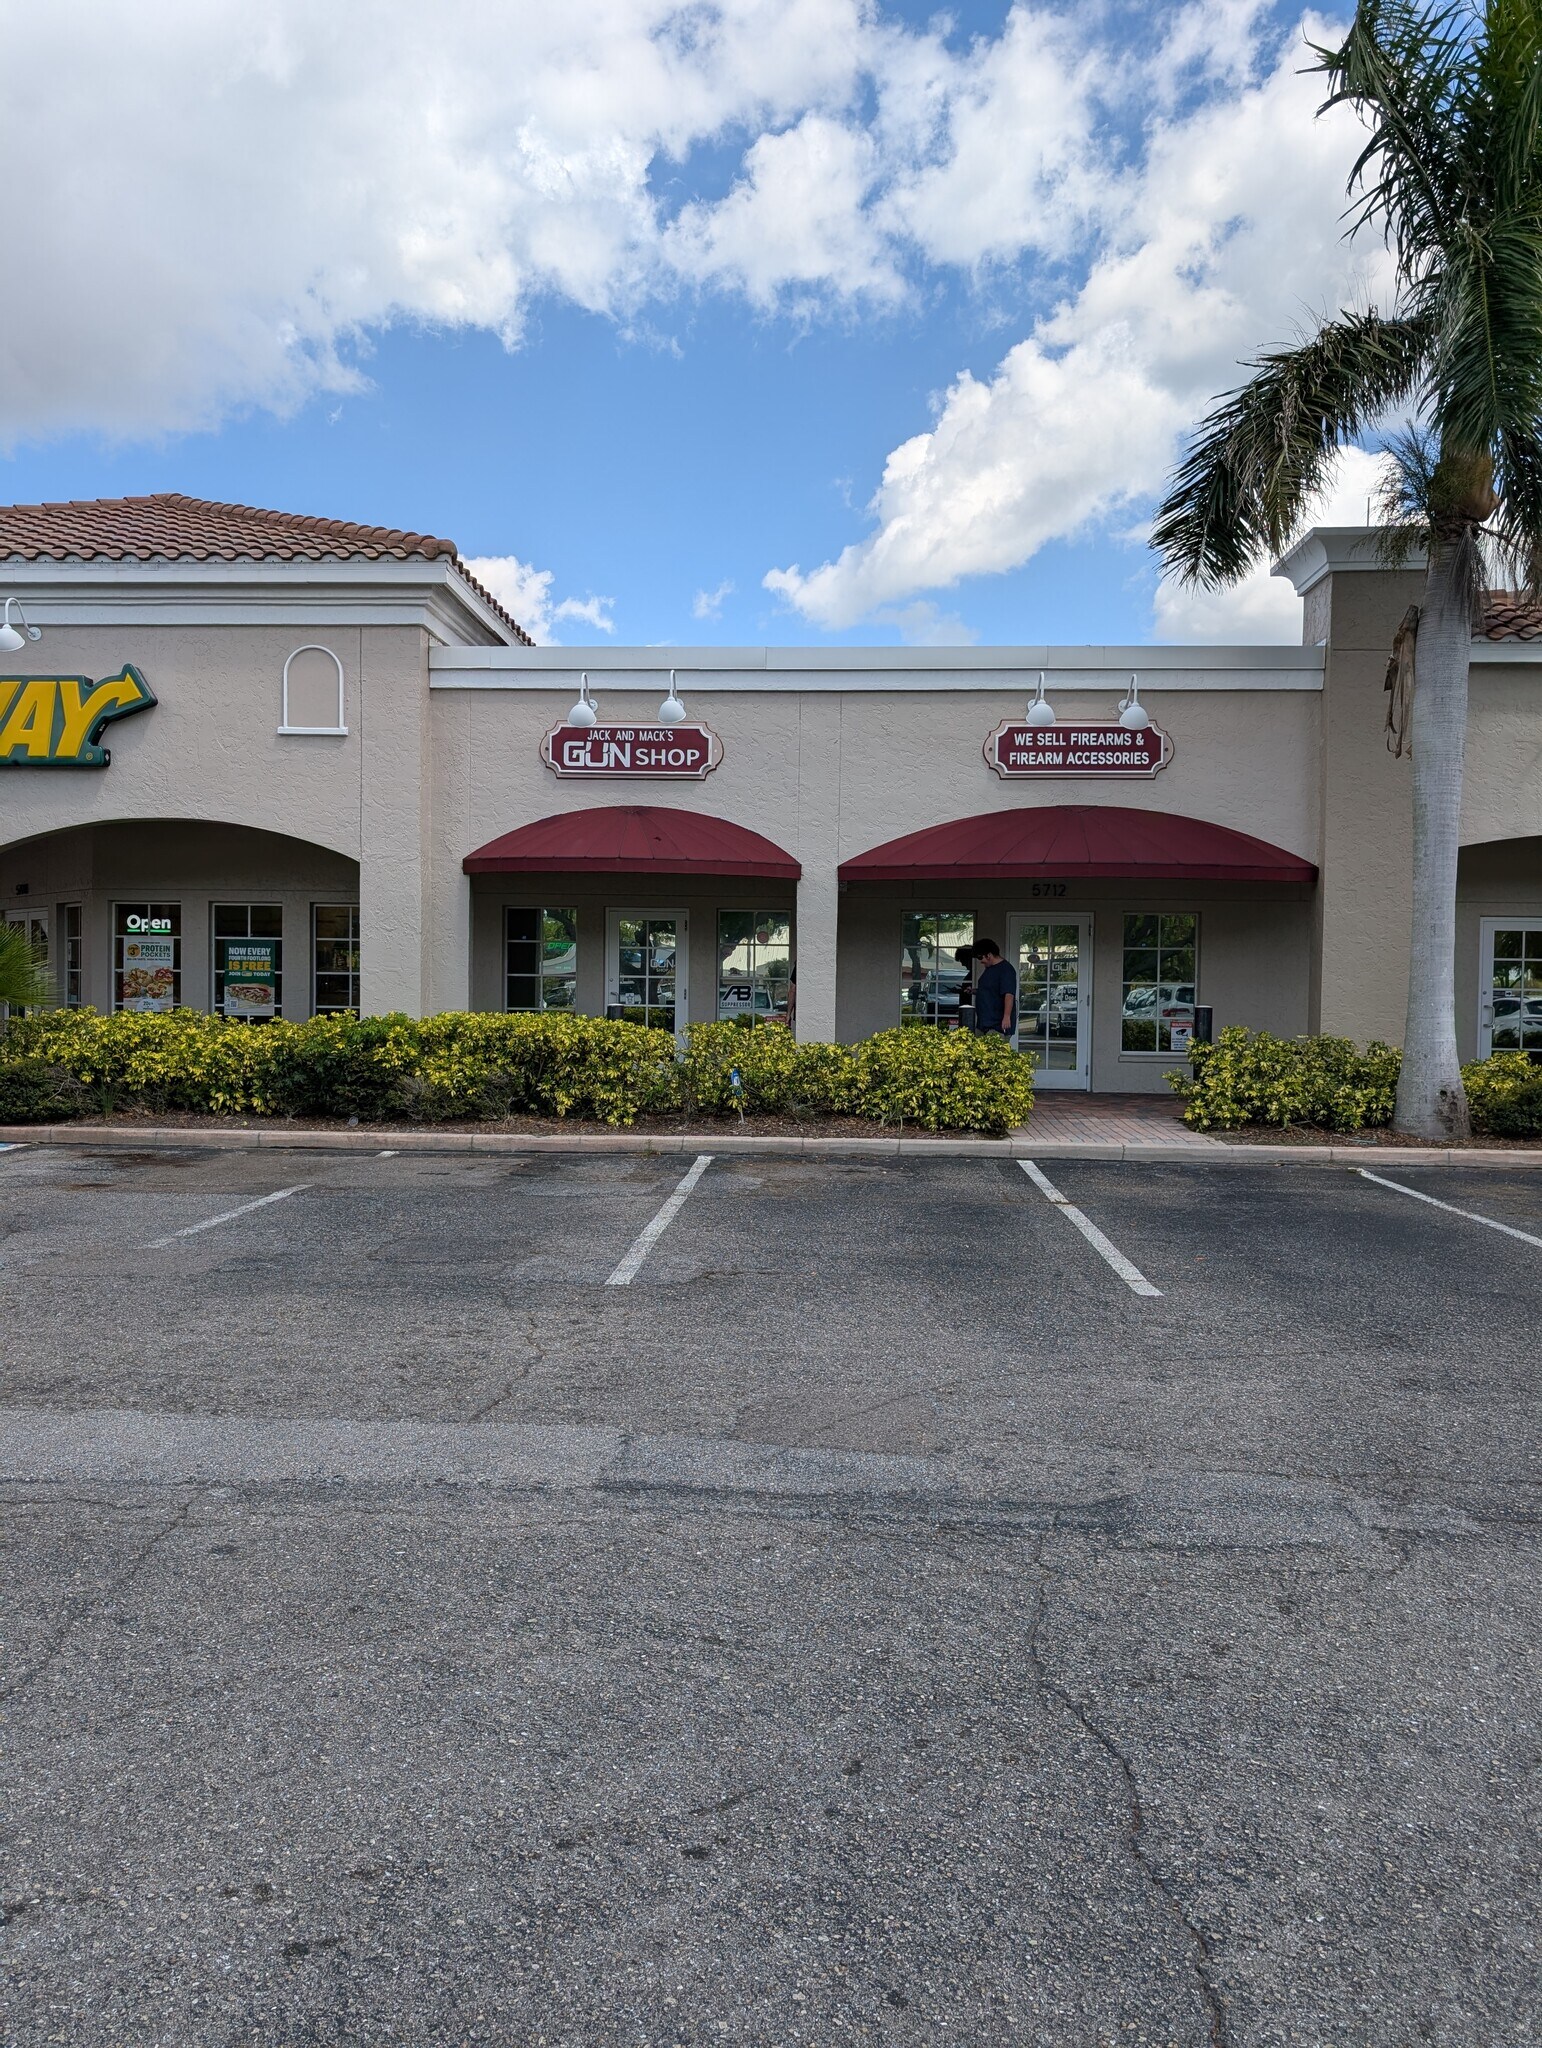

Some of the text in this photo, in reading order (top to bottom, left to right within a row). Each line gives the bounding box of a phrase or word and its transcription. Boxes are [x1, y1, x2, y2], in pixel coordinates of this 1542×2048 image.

[587, 730, 674, 742] JACK AND MACK'S
[1014, 733, 1145, 746] WE SELL FIREARMS &
[563, 741, 700, 768] GUN SHOP
[1009, 752, 1150, 765] FIREARM ACCESSORIES
[1032, 883, 1067, 897] 5712
[126, 914, 172, 933] Open
[141, 944, 171, 953] PROTEIN
[228, 947, 271, 956] NOW EVERY
[228, 961, 271, 971] IS FREE
[650, 958, 674, 969] GUN
[1052, 961, 1078, 972] GUN
[722, 984, 752, 1001] AB
